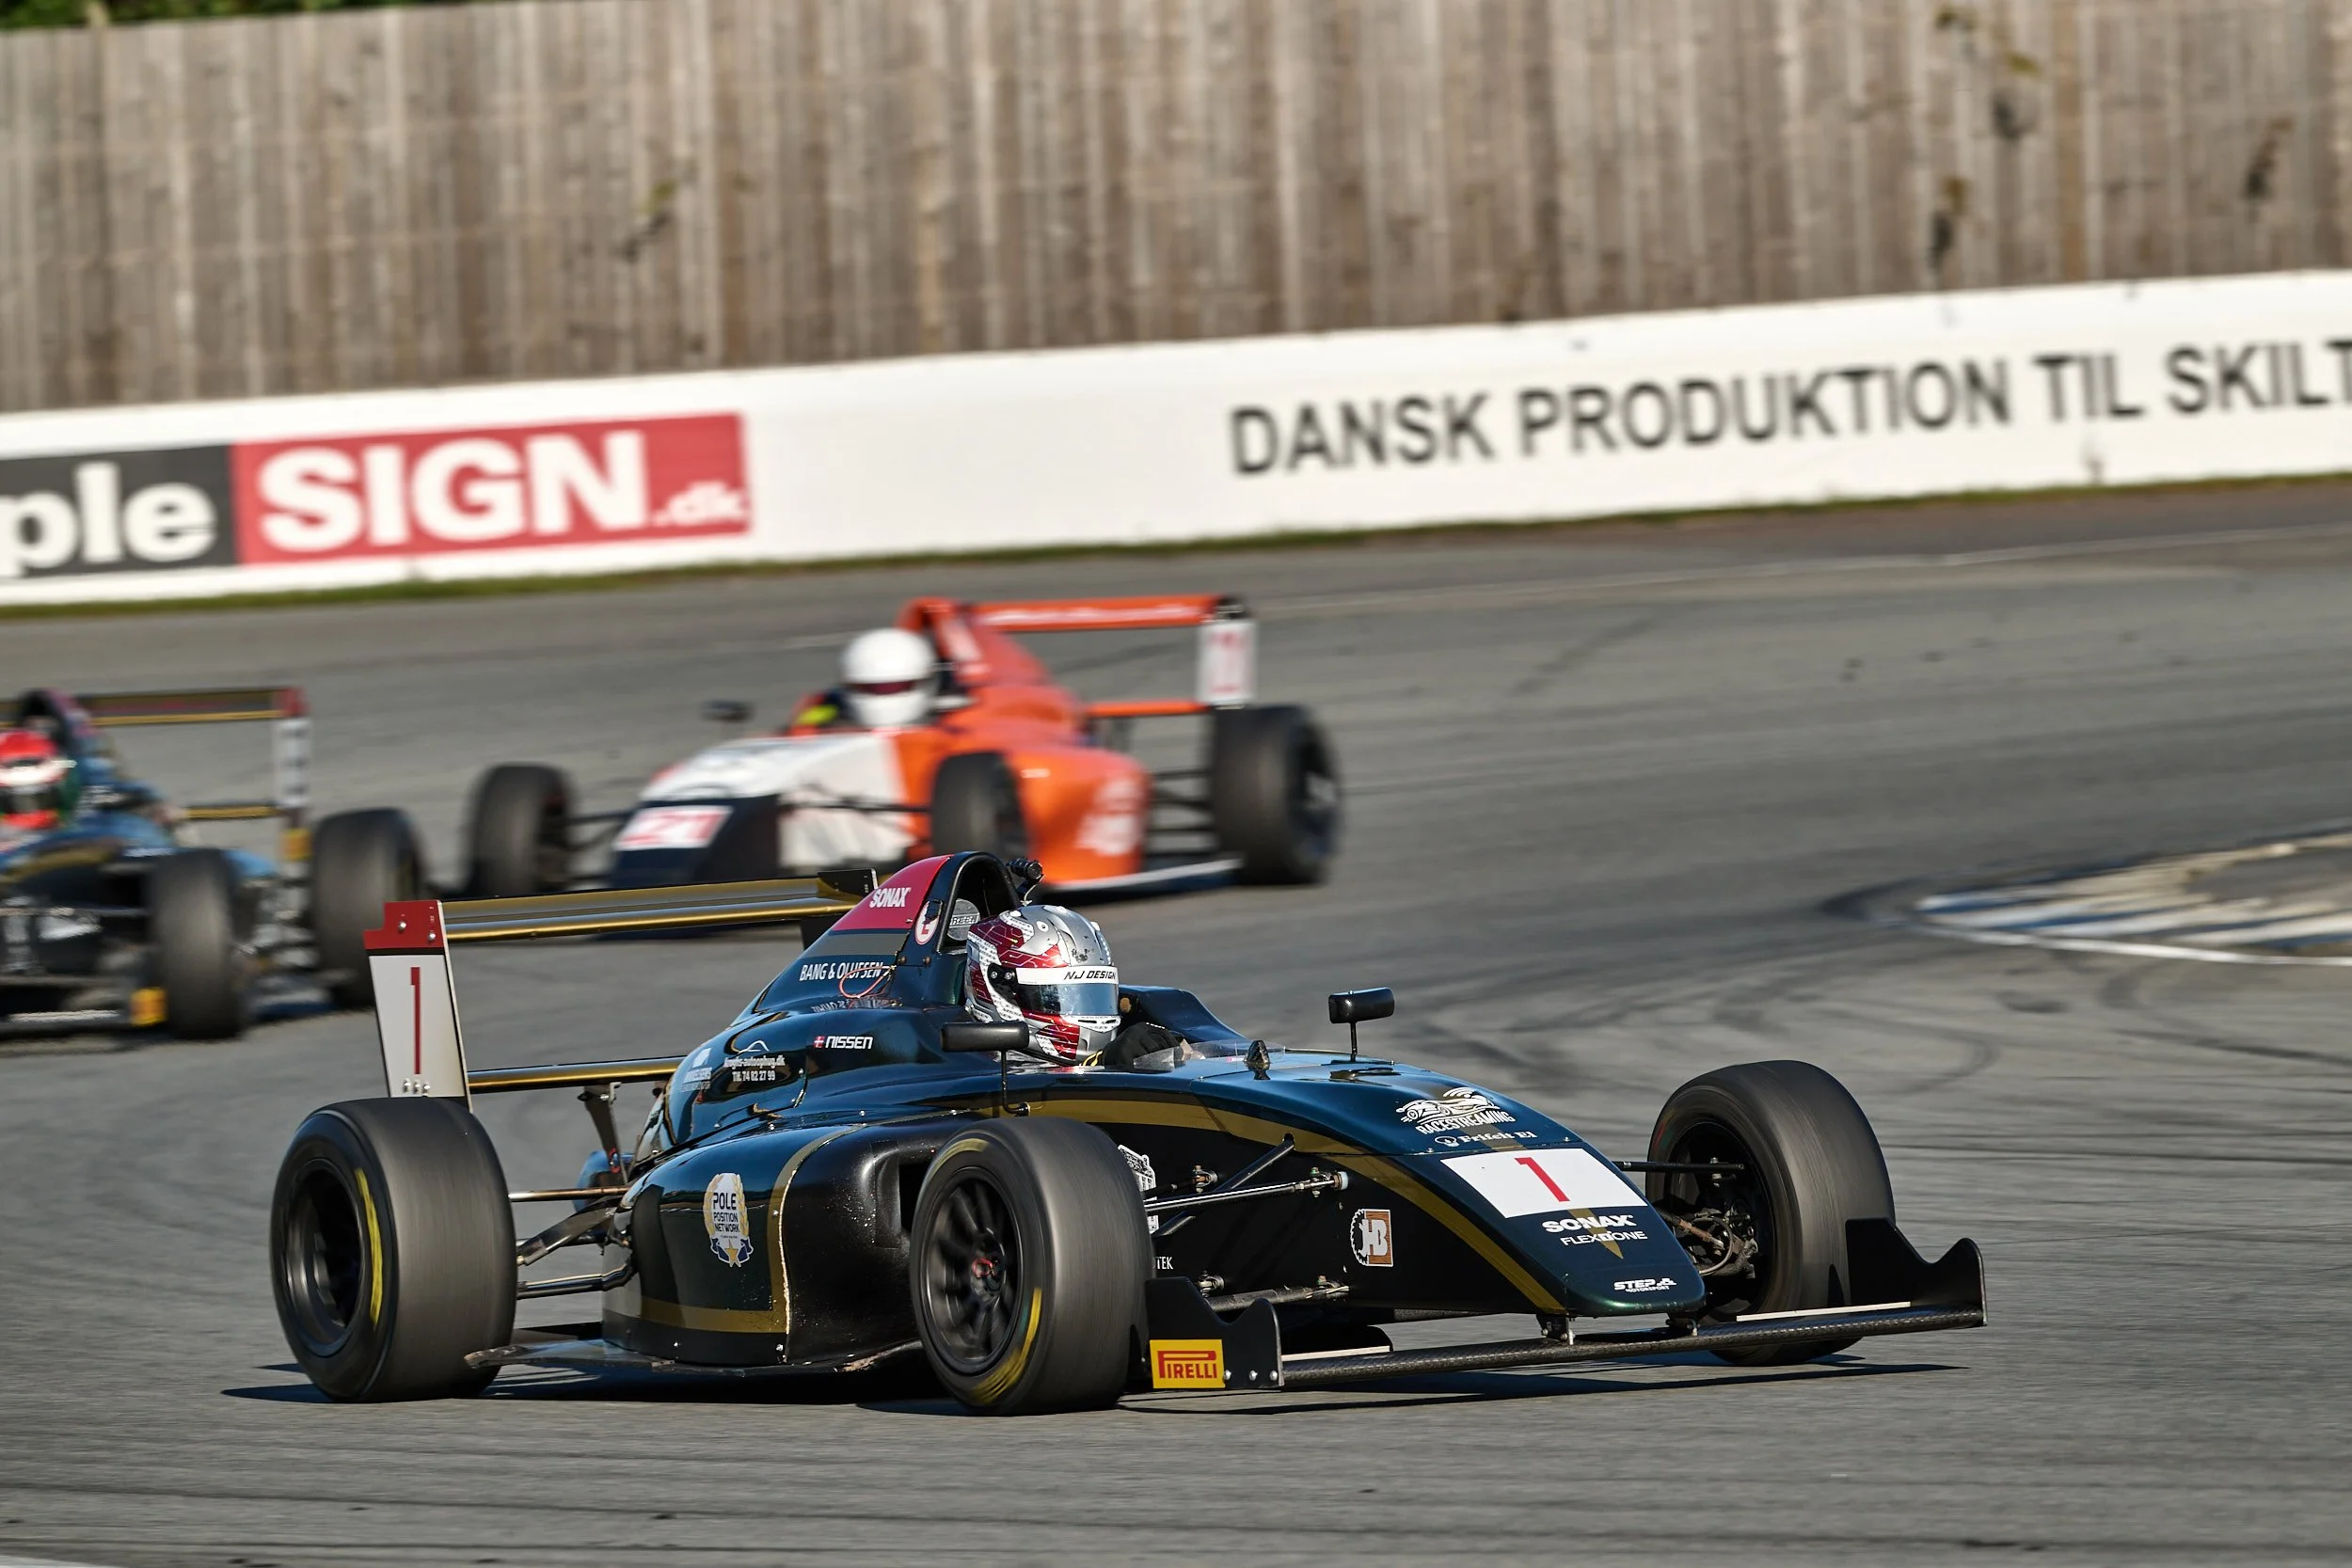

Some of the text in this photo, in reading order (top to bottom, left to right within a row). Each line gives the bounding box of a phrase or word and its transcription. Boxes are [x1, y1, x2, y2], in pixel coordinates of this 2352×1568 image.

[1231, 337, 2352, 478] DANSK PRODUKTION TIL SKILT
[0, 460, 216, 578] ple
[869, 886, 912, 909] SONAX
[799, 963, 829, 981] BANG
[828, 962, 836, 979] &
[1063, 970, 1116, 980] NJ DESIGN
[410, 966, 421, 1075] 1
[825, 1036, 873, 1050] NISSEN
[759, 1069, 767, 1081] 27
[767, 1069, 776, 1081] 99
[1415, 1110, 1517, 1135] RACESTREAMING
[1514, 1157, 1570, 1202] 1
[713, 1193, 737, 1211] POLE
[713, 1212, 738, 1223] POSITION
[1542, 1214, 1637, 1233] SONAX
[715, 1223, 740, 1233] NETWORK
[1613, 1278, 1656, 1291] STEP
[1157, 1351, 1217, 1379] PIRELLI
